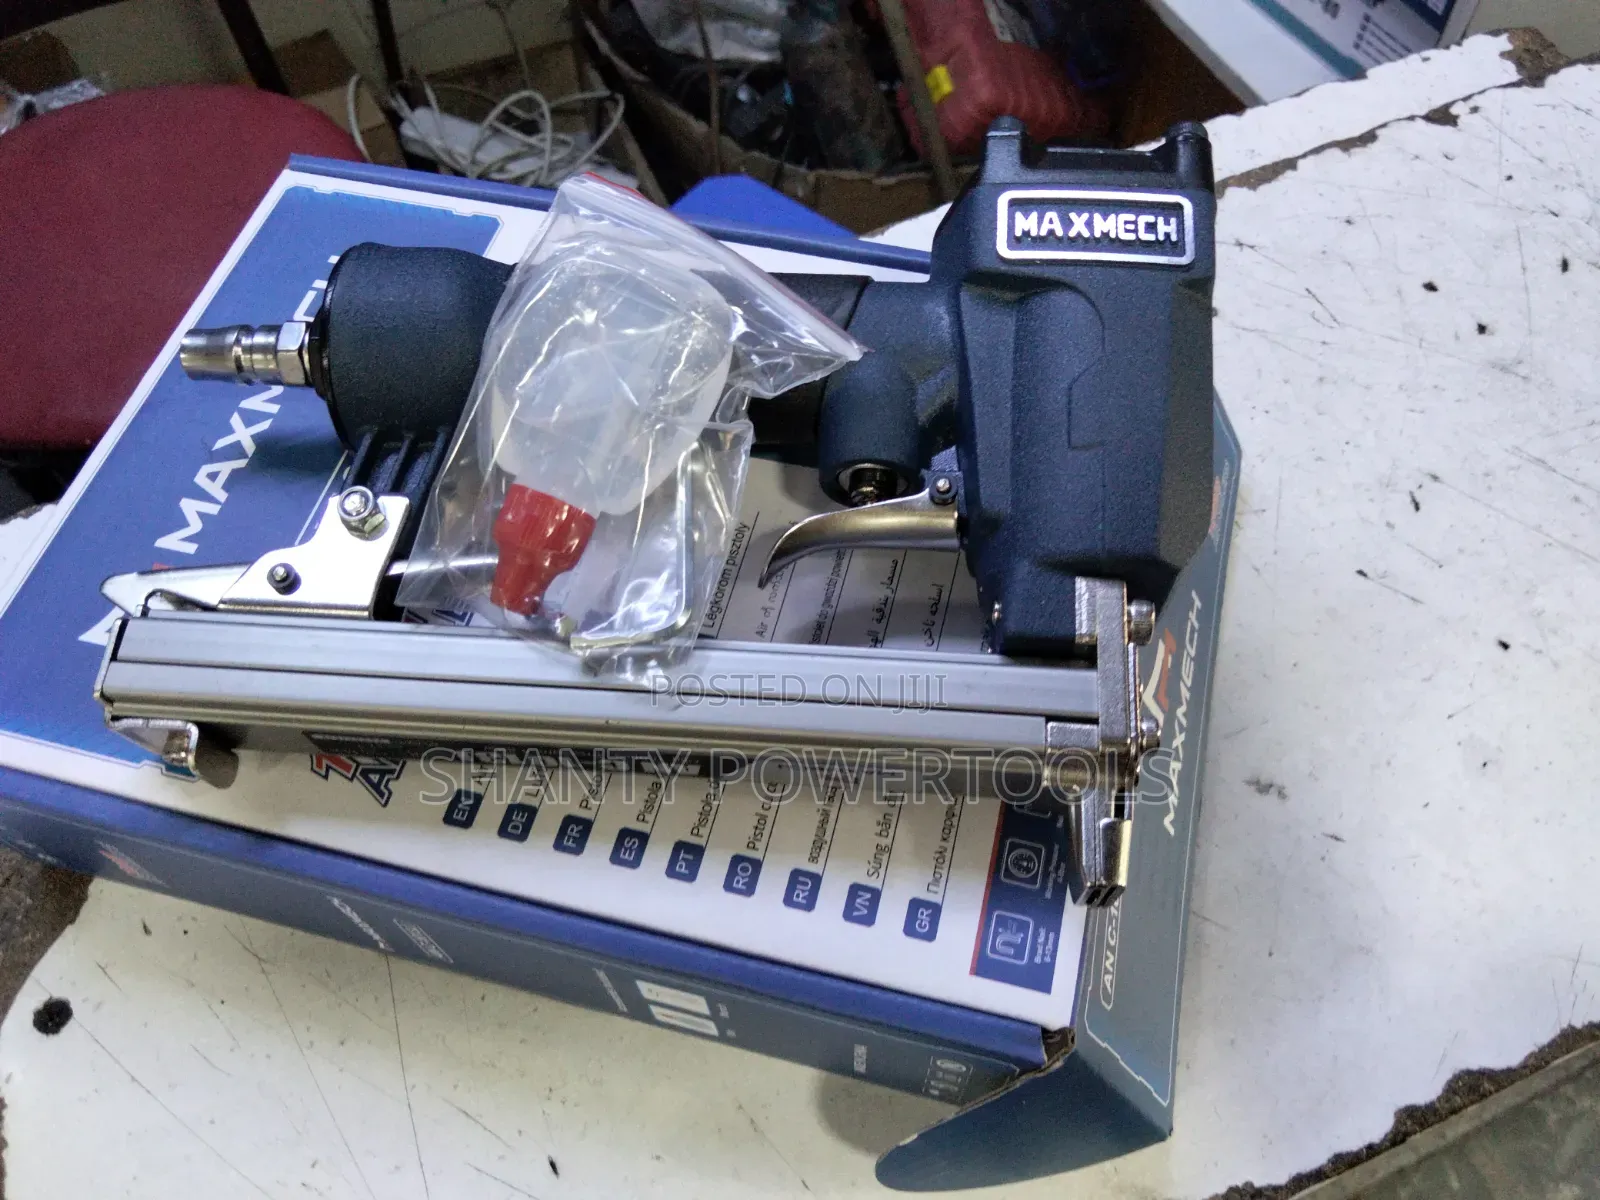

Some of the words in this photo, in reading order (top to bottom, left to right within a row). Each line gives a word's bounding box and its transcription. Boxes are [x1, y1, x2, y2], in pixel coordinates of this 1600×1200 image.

[1014, 211, 1178, 242] MAXMECH
[1163, 590, 1202, 837] MAXMECH
[453, 796, 473, 821] EN
[507, 810, 528, 835] DE
[564, 823, 583, 847] FR
[747, 811, 769, 851] Pistol
[620, 836, 639, 861] ES
[676, 848, 694, 874] PT
[867, 843, 890, 879] Súng
[733, 862, 752, 889] RO
[793, 876, 811, 903] RU
[853, 891, 871, 917] VN
[915, 907, 932, 933] GR
[1103, 955, 1115, 996] AN
